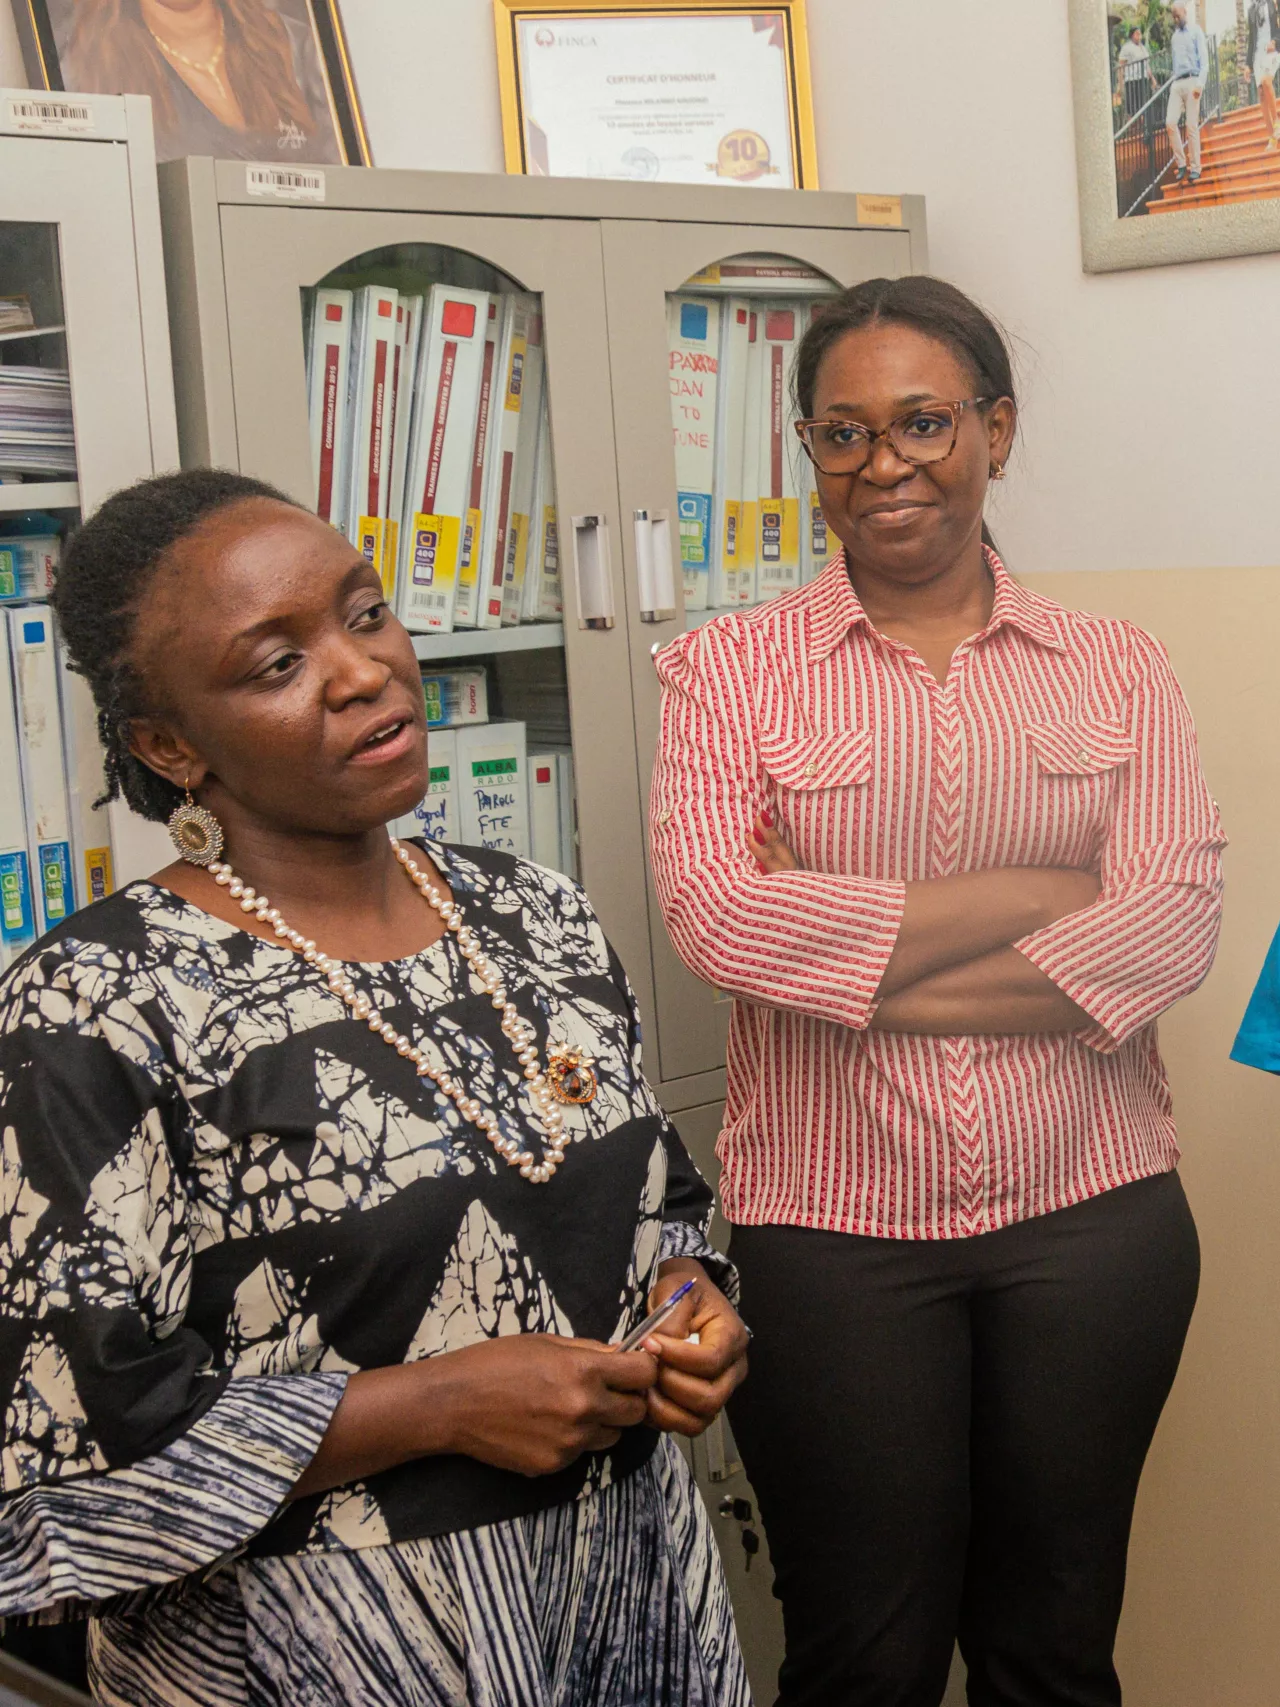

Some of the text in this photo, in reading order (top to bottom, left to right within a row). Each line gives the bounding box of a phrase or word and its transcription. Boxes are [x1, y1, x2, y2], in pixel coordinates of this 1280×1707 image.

[606, 73, 716, 84] CERTIFICAT D'HONNEUR
[726, 137, 757, 161] 10
[670, 377, 704, 398] JAN
[325, 384, 336, 449] COMMUNICATION
[680, 406, 700, 420] TO
[428, 462, 438, 498] TRAINEES
[433, 428, 443, 461] PAYROLL
[438, 387, 449, 424] SEMESTER
[45, 555, 53, 587] boran
[469, 685, 477, 715] boran
[477, 762, 514, 774] ALBA
[478, 774, 514, 784] RADO
[478, 815, 512, 835] FTE
